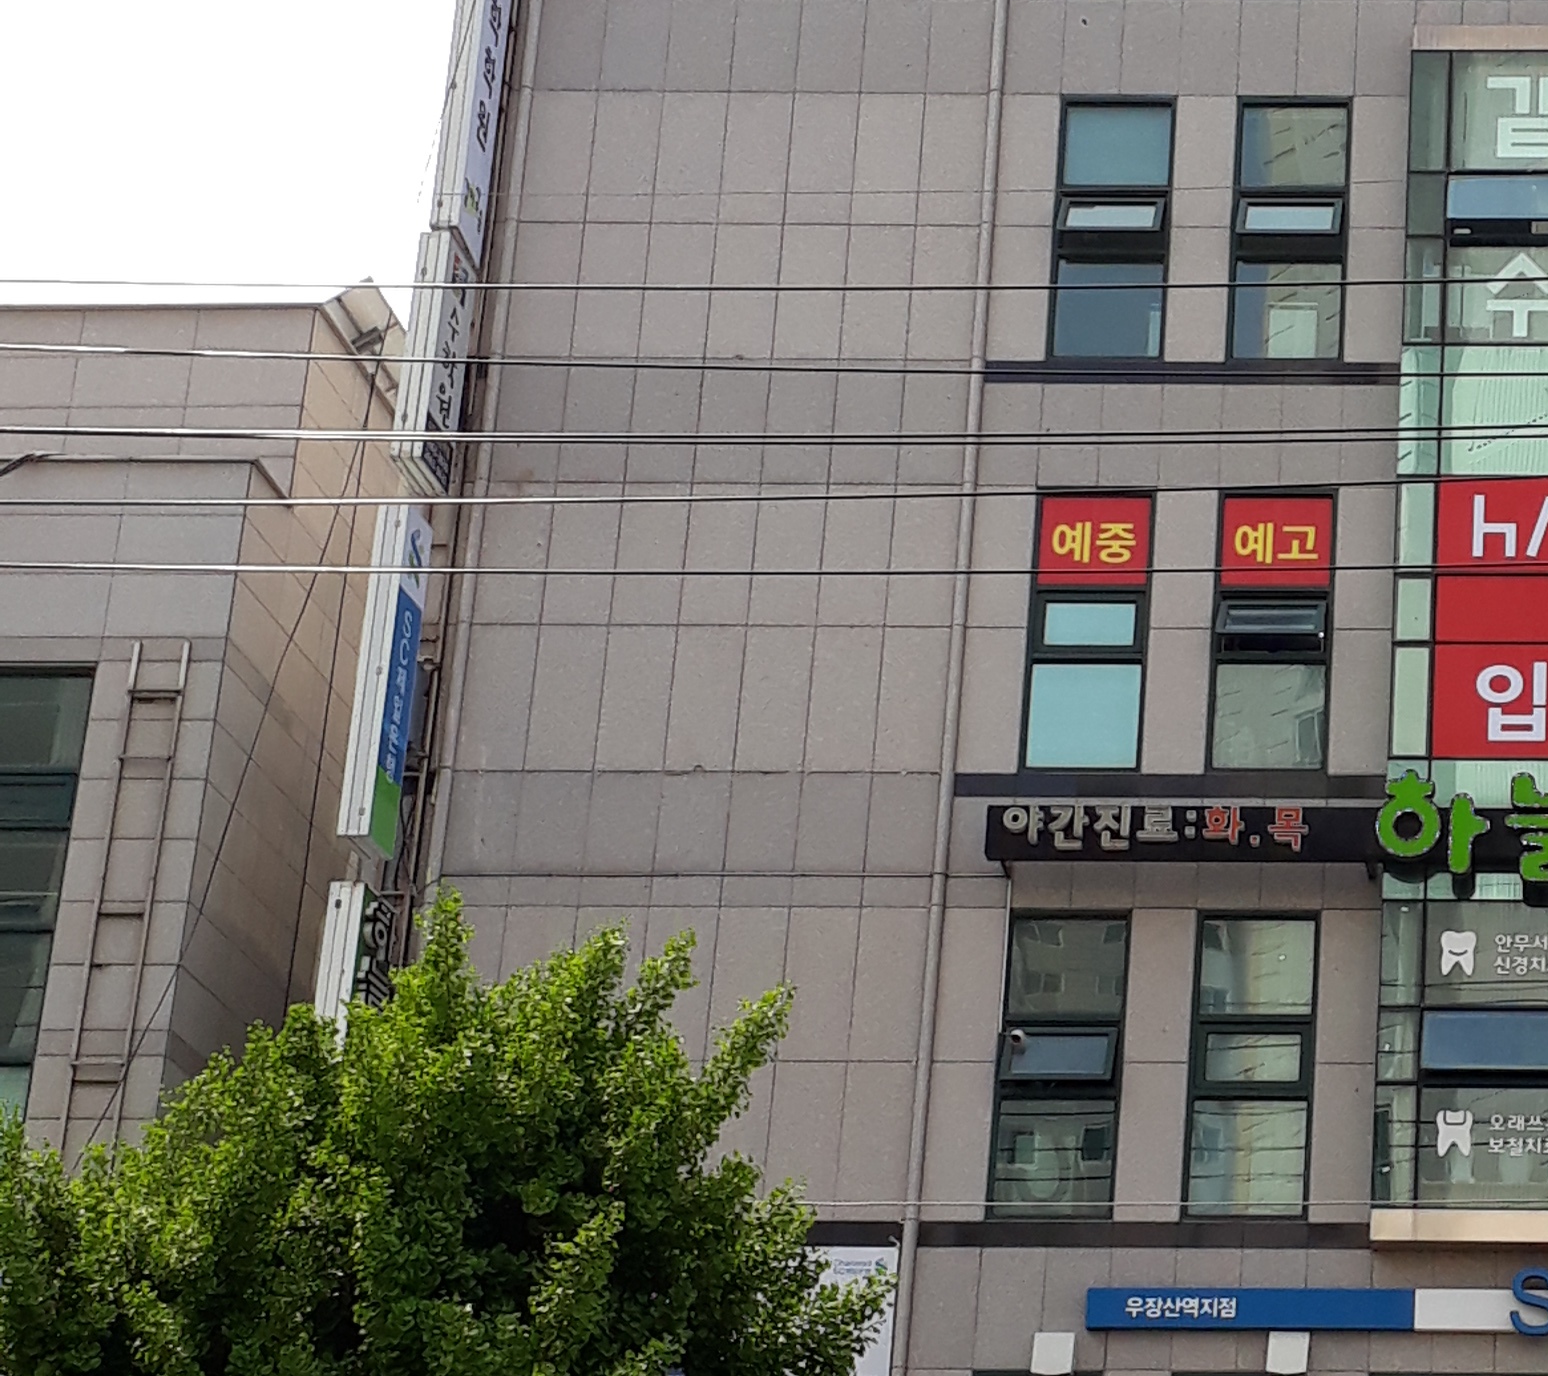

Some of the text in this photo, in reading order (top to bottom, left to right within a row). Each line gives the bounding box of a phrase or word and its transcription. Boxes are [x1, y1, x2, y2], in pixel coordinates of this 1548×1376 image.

[1051, 521, 1137, 564] 예중
[1234, 521, 1320, 564] 예고
[1124, 1296, 1238, 1319] 우장산역지점
